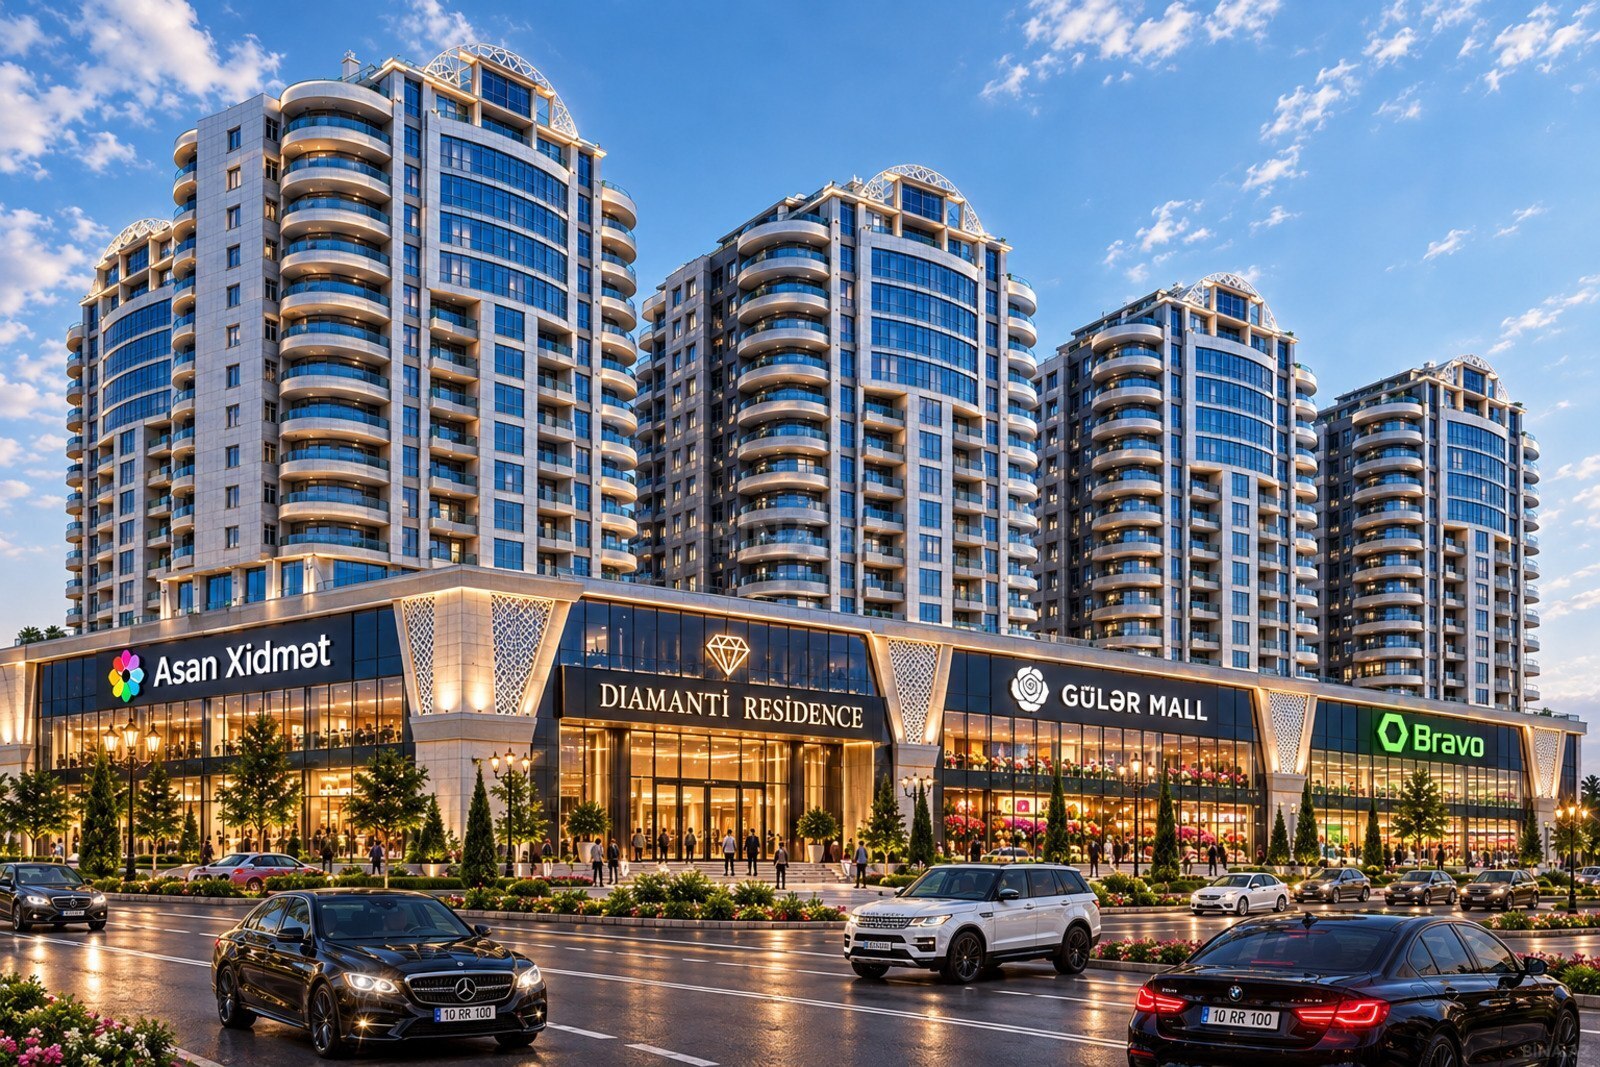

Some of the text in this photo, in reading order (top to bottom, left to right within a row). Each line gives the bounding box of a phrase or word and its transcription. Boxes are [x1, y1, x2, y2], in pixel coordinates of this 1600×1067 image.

[153, 634, 331, 688] Asan Xidmət
[600, 683, 864, 729] DIAMANTİ RESİDENCE
[1150, 694, 1208, 722] MALL
[1414, 723, 1484, 758] Bravo
[444, 1006, 491, 1020] 10 RR 100
[1214, 1009, 1272, 1026] 10 RR 100
